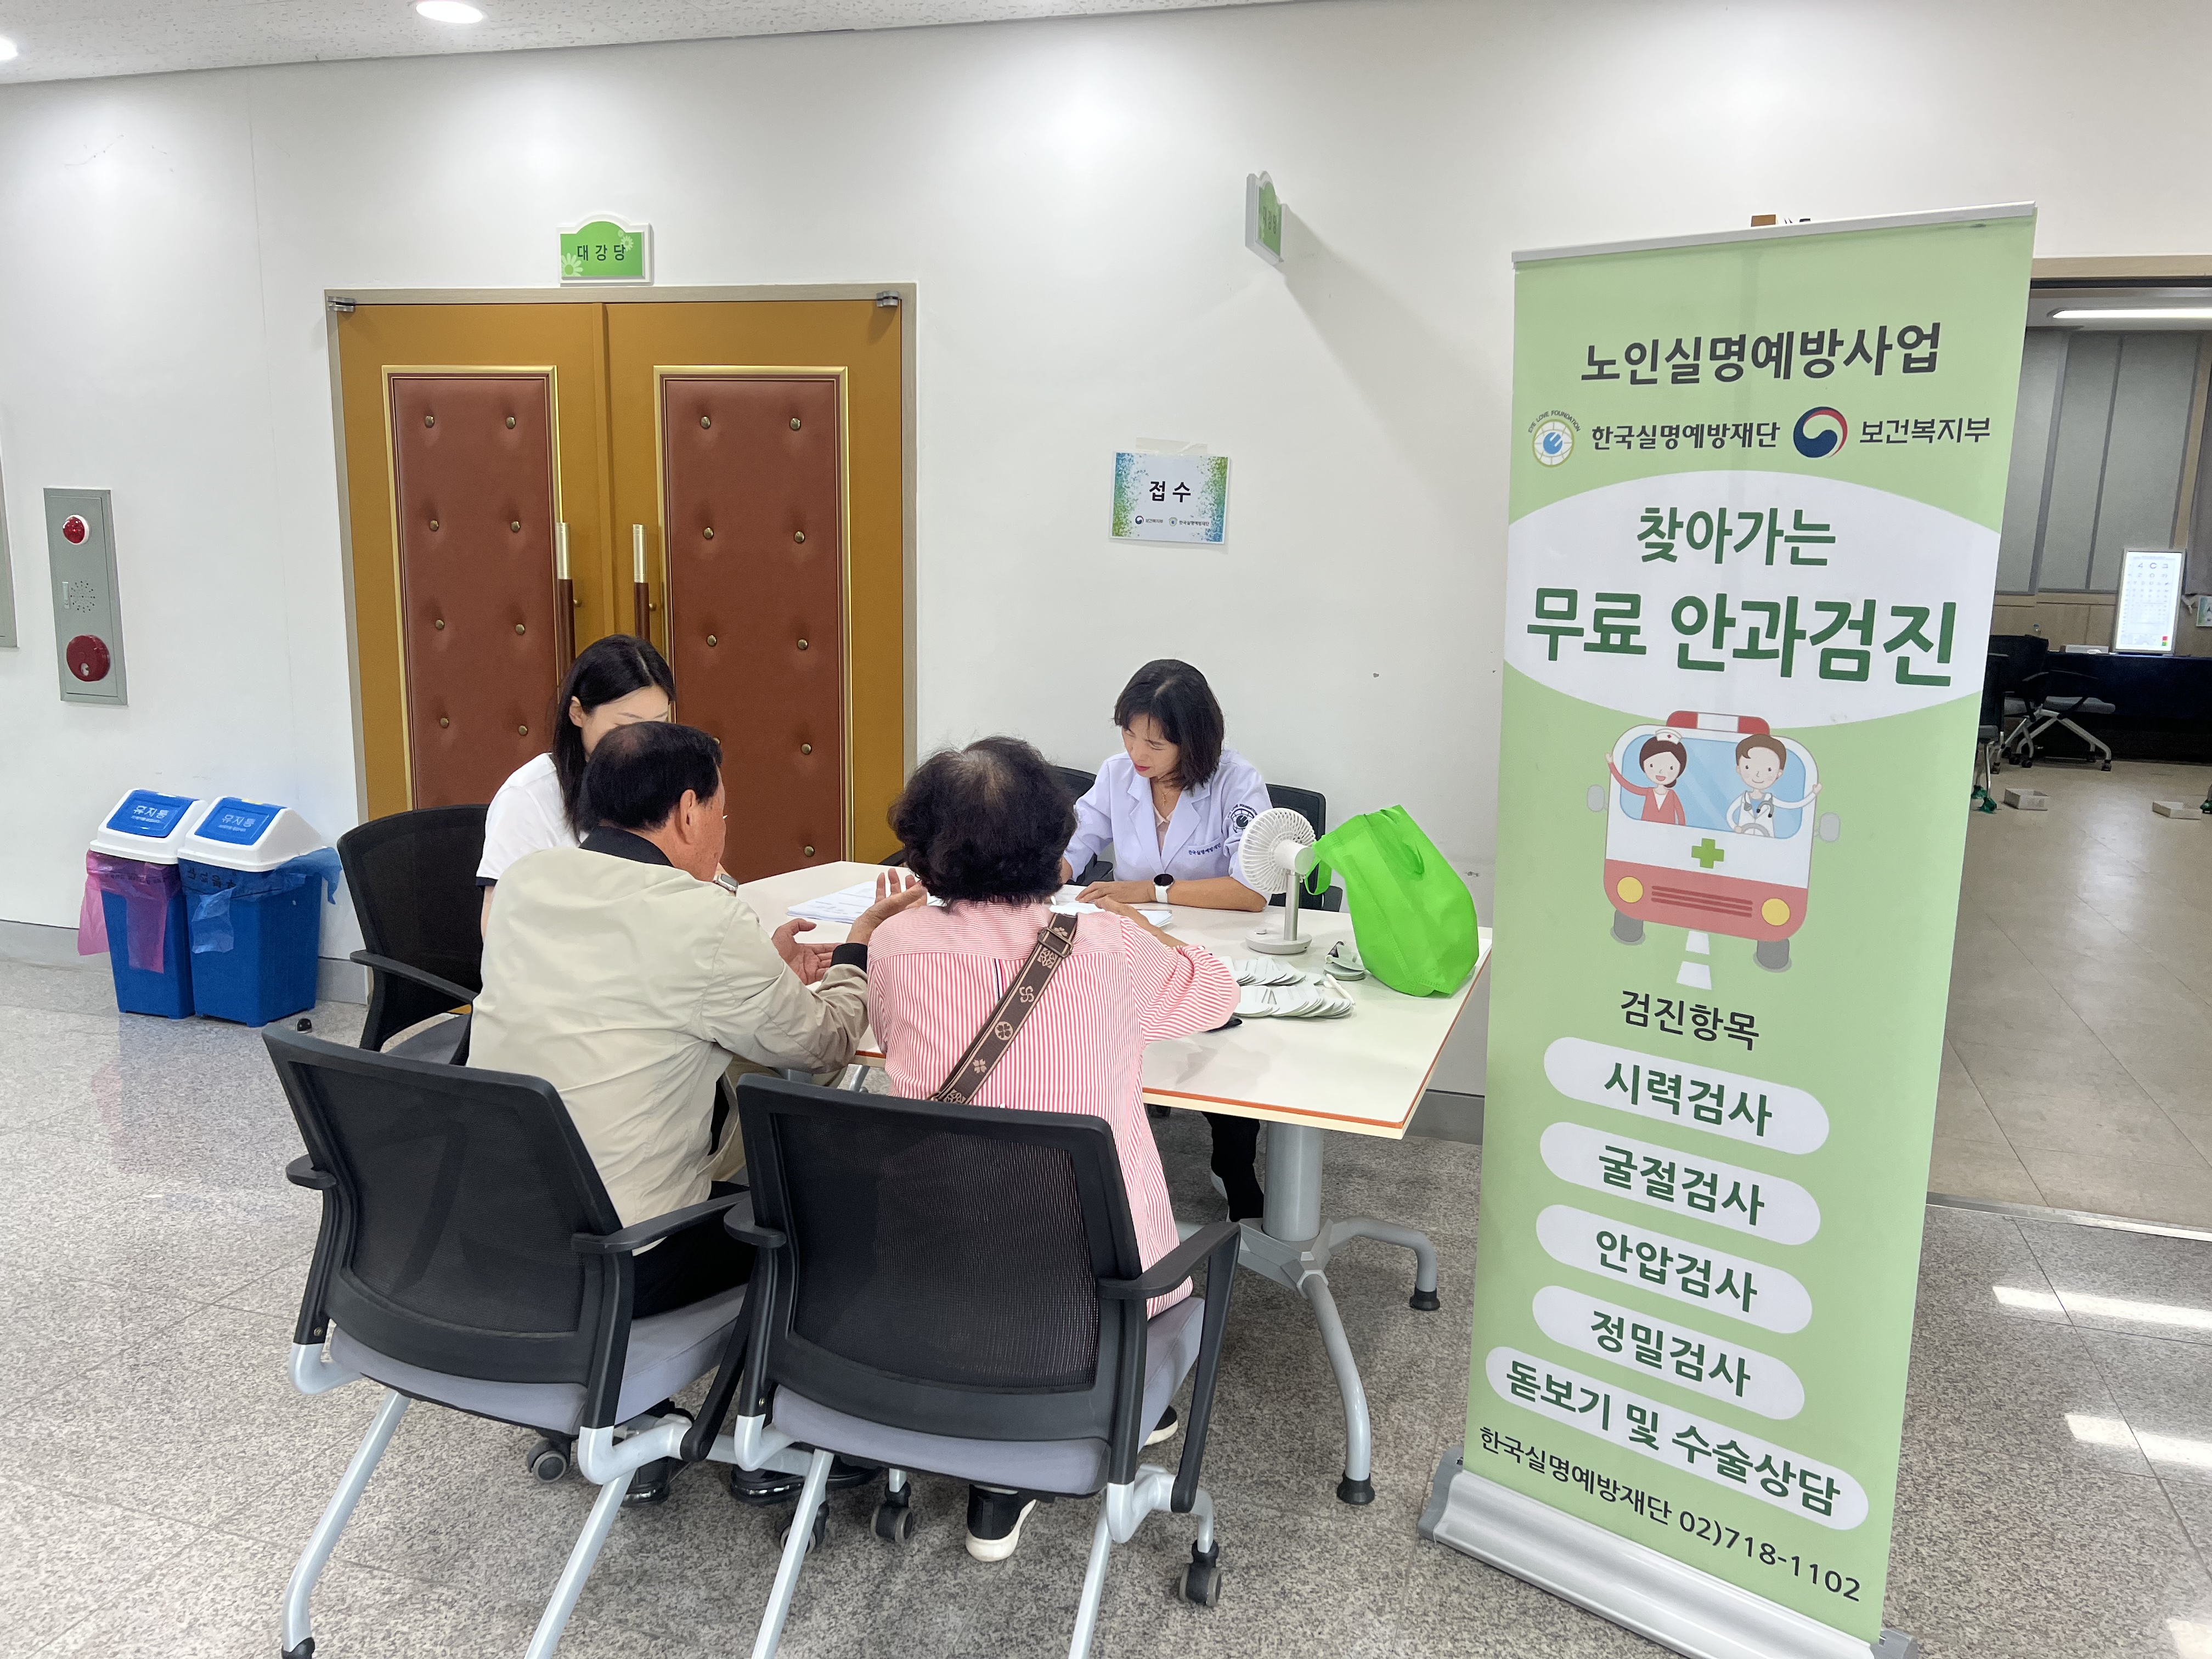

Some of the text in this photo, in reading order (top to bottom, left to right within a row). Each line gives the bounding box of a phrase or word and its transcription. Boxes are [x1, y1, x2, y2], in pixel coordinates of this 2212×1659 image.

[577, 244, 626, 261] 대강당
[1581, 321, 1941, 386] 노인실명예방사업
[1536, 411, 1549, 422] LOVE
[1551, 410, 1581, 432] FOUNDATION
[1592, 422, 1781, 450] 한국실명예방재단
[1859, 417, 1991, 444] 보건복지부
[1637, 507, 1837, 566] 찾아가는
[1527, 587, 1957, 687] 무료 안과검진
[1620, 990, 1760, 1051] 검진항목
[1604, 1062, 1773, 1137] 시력검사
[1599, 1144, 1765, 1227] 굴절검사
[1595, 1230, 1758, 1313] 안압검사
[1590, 1310, 1751, 1397] 정밀검사
[1506, 1359, 1841, 1517] 돋보기 및 수술상담
[1479, 1426, 1861, 1602] 한국실명예방재단 02)718-1102
